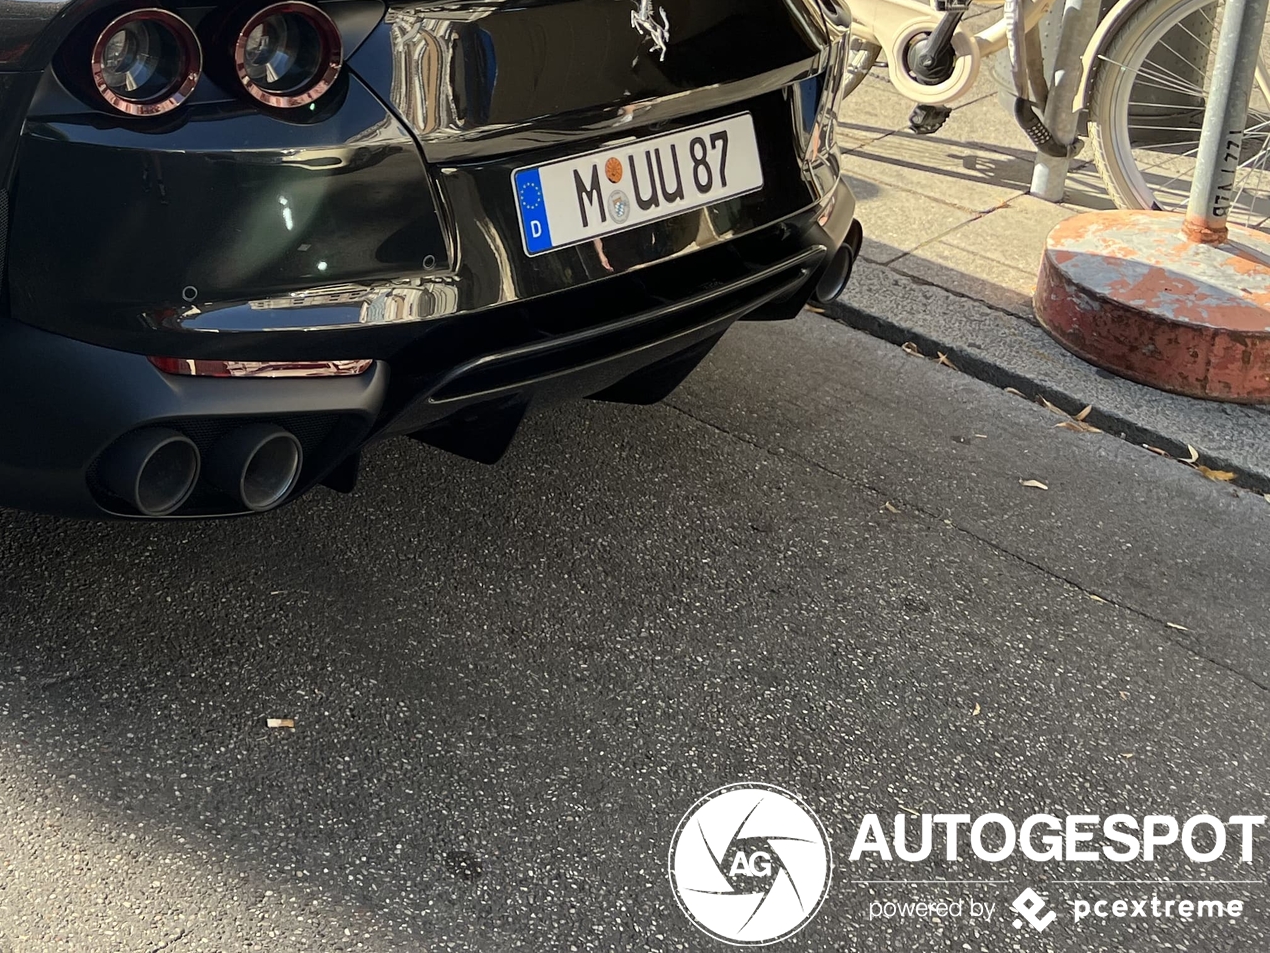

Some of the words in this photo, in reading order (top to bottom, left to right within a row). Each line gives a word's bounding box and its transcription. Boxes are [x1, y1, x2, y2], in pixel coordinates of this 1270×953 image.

[573, 164, 607, 228] M
[628, 144, 685, 212] UU
[689, 130, 729, 194] 87
[530, 220, 542, 238] D
